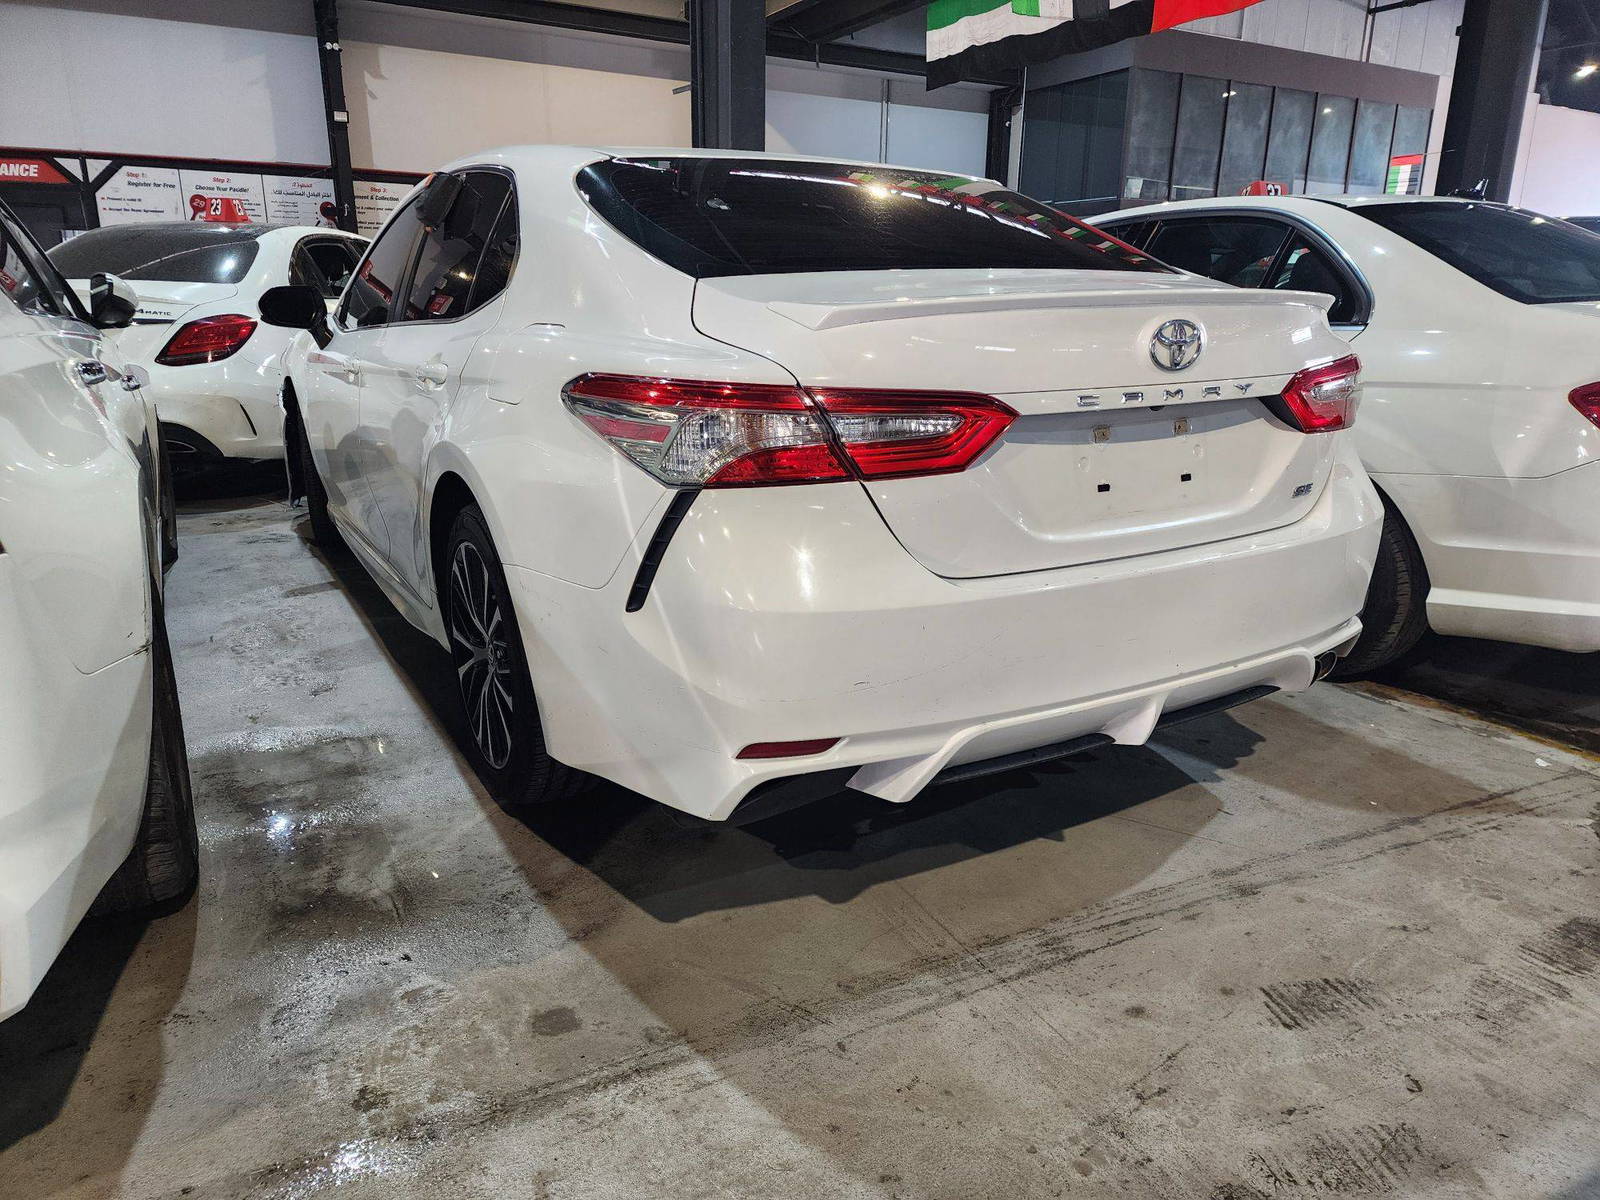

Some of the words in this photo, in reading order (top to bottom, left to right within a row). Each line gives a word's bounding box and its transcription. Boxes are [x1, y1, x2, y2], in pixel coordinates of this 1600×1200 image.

[127, 180, 151, 188] Register
[210, 198, 222, 215] 23
[136, 308, 172, 316] 4MATIC
[1077, 383, 1255, 408] CAMRY
